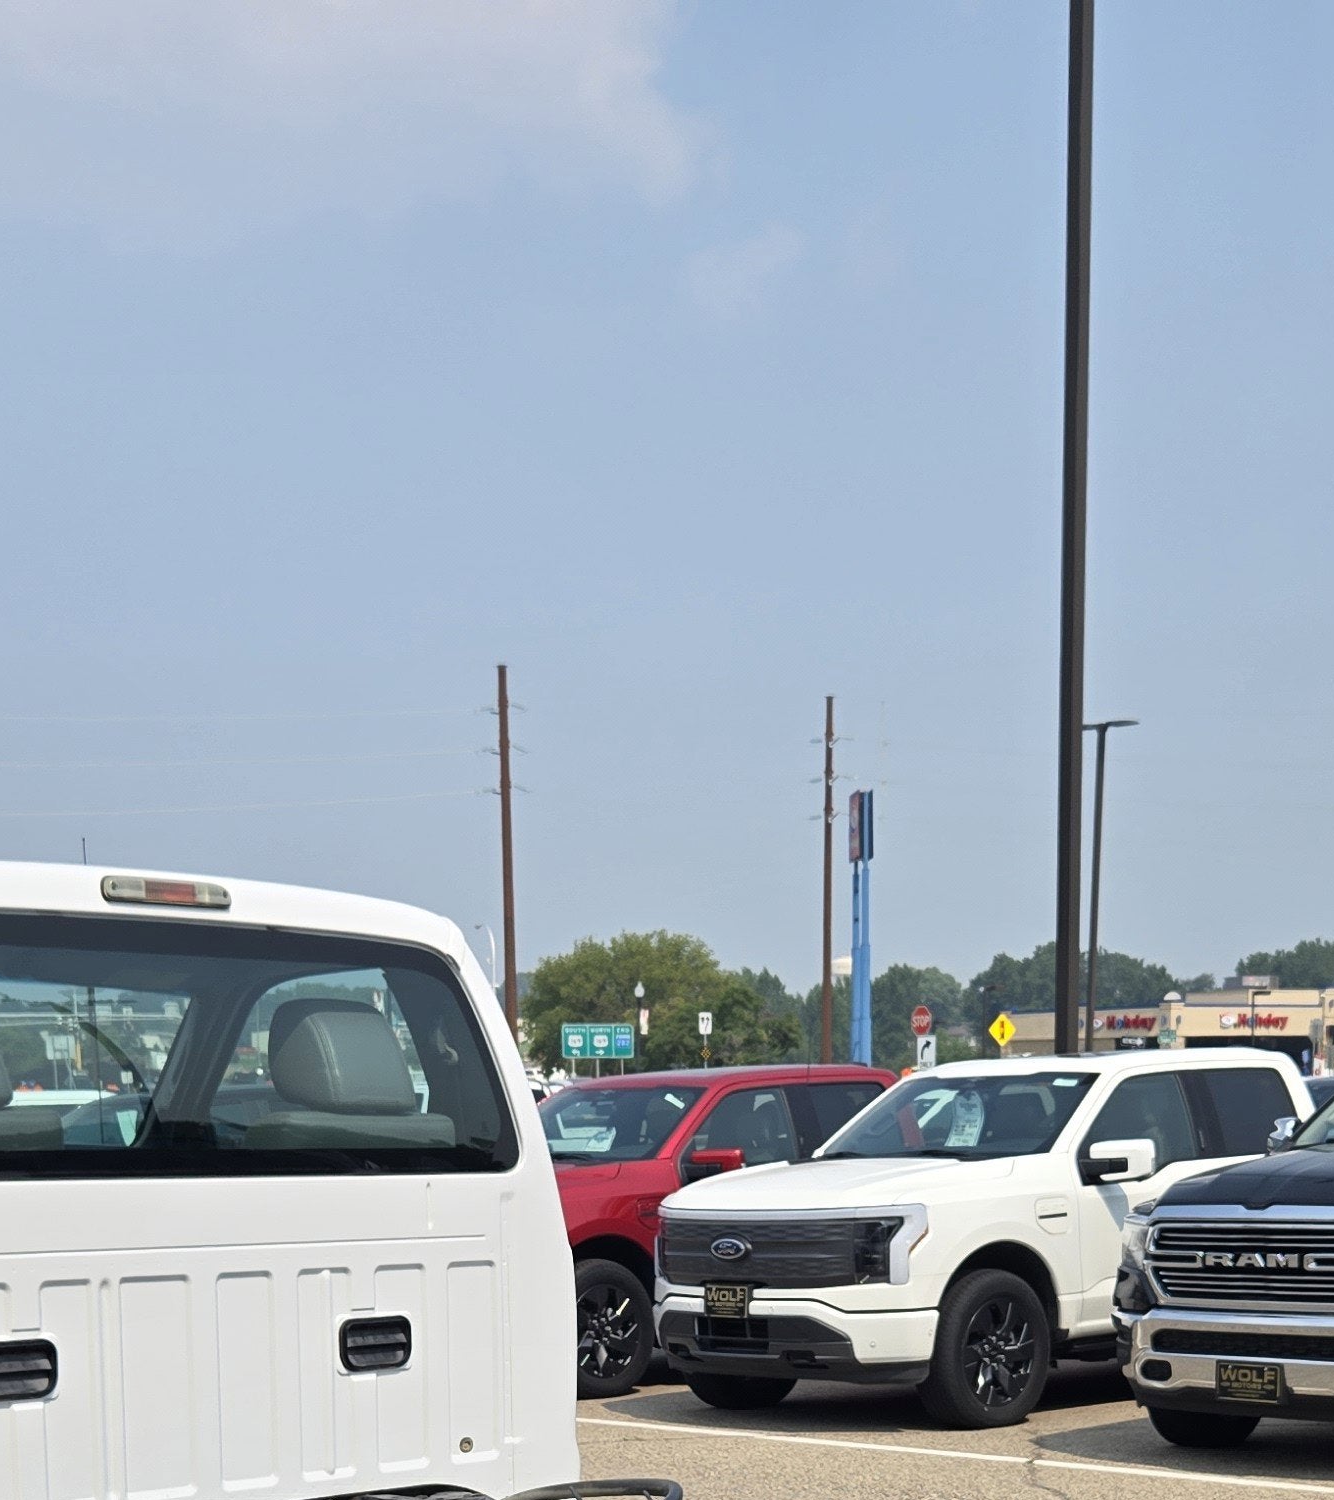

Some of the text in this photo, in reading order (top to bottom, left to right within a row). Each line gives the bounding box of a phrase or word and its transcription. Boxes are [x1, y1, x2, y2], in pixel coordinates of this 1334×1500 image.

[912, 1015, 931, 1028] STOP
[1205, 1252, 1299, 1269] RAM
[707, 1288, 745, 1302] WOLF
[1220, 1368, 1275, 1383] WOLF
